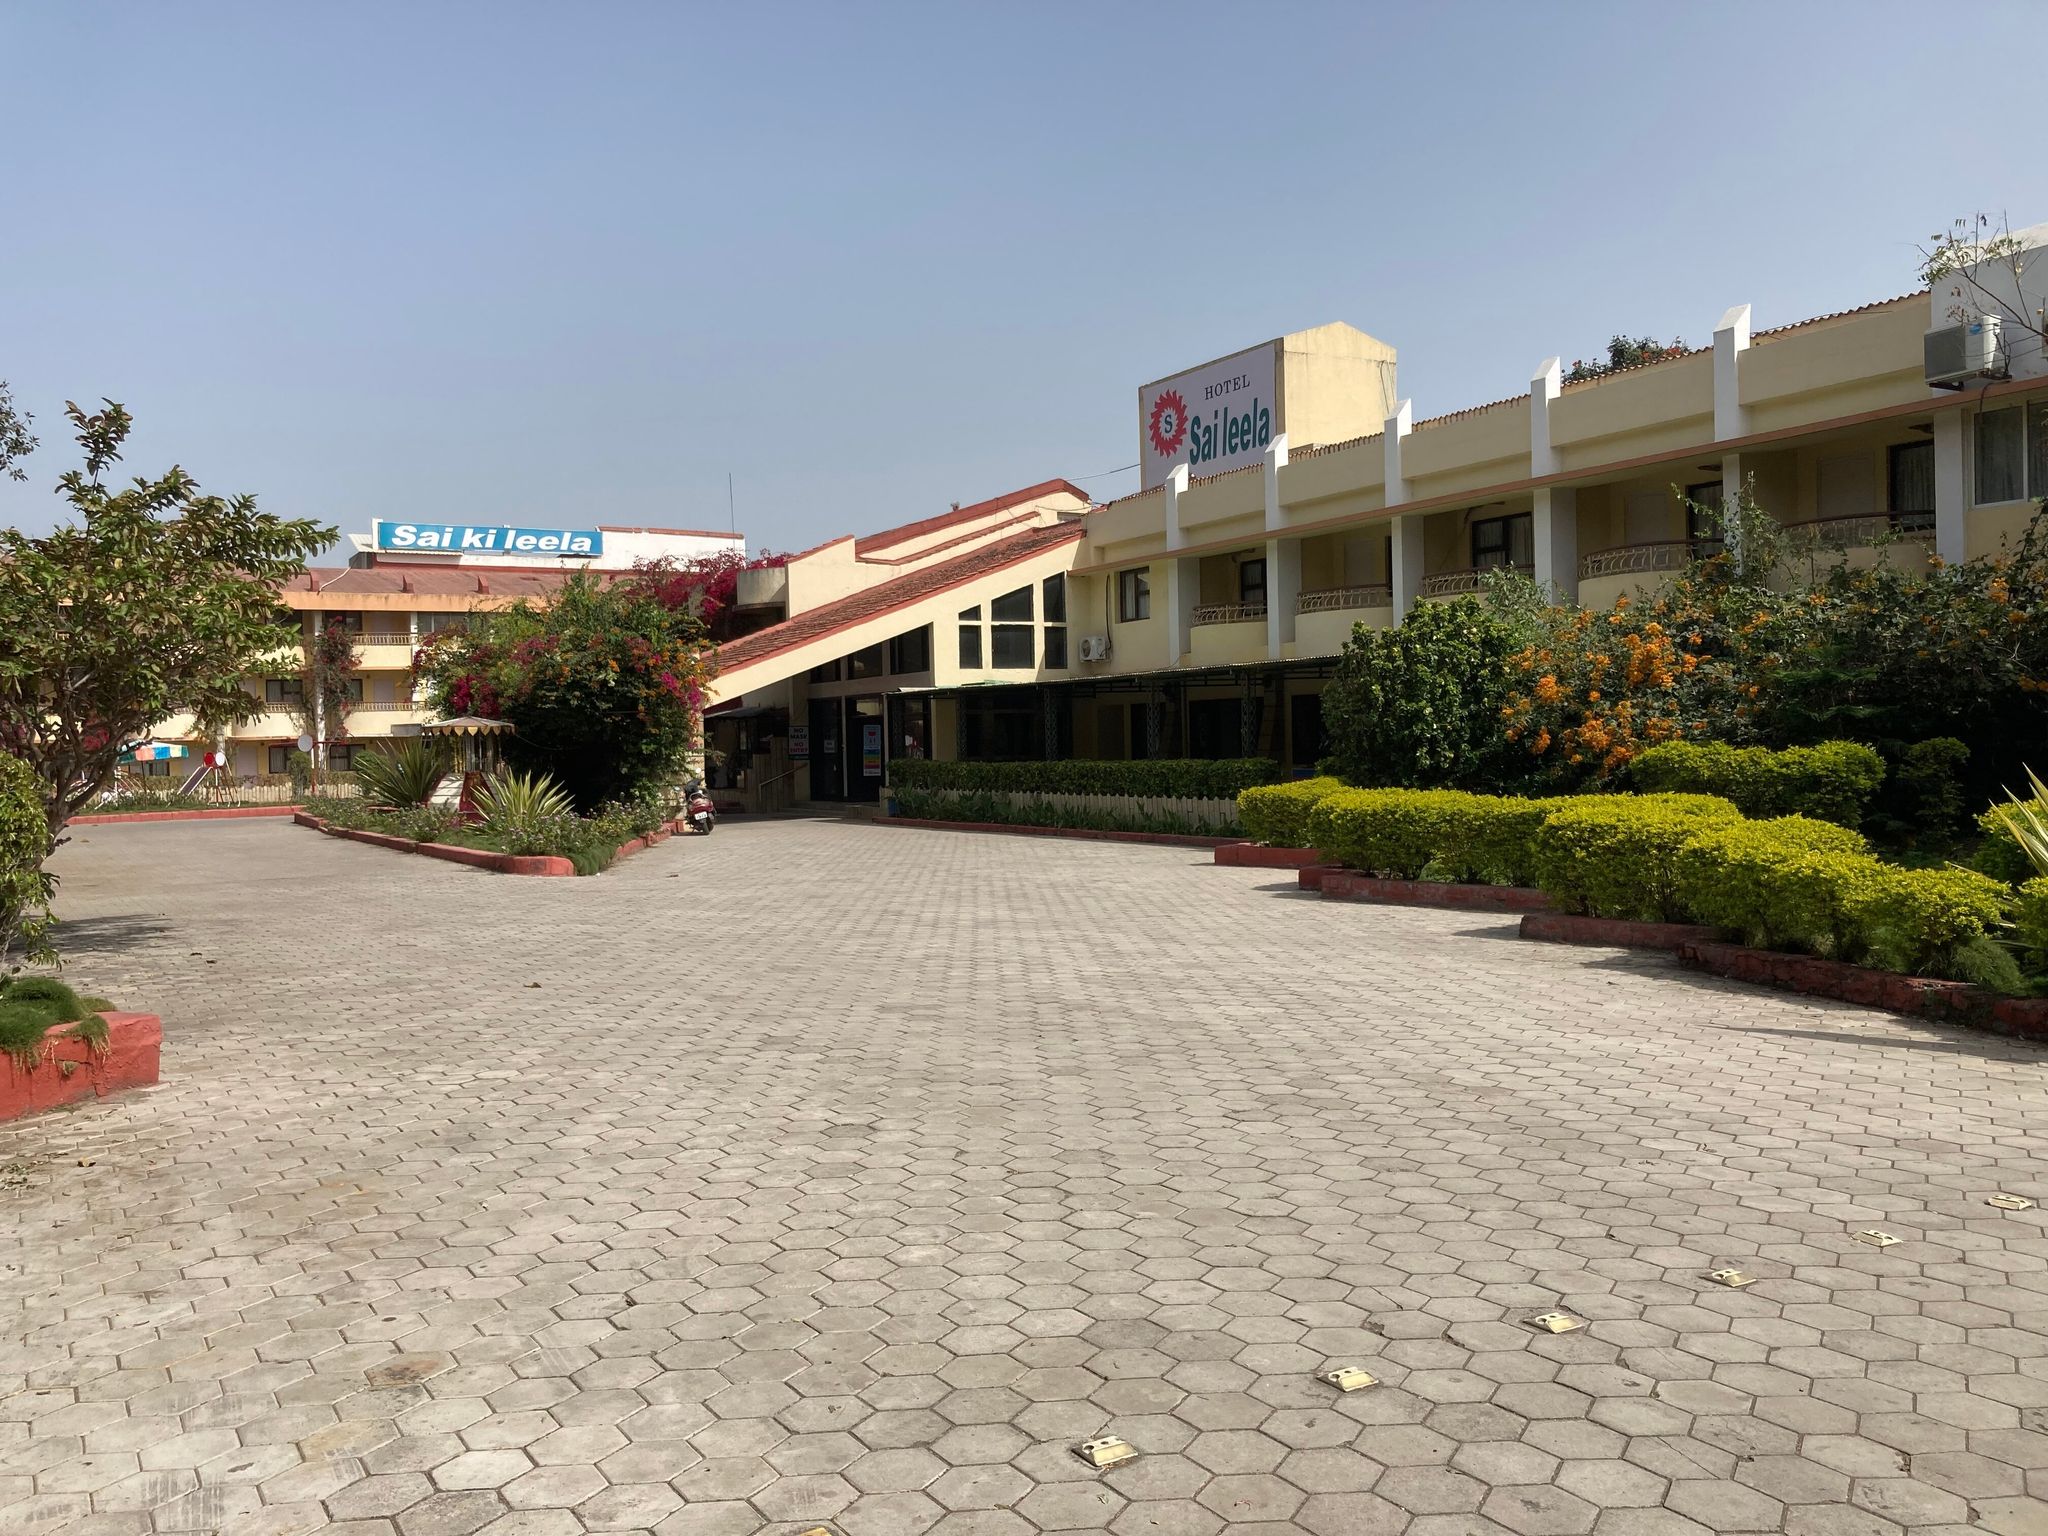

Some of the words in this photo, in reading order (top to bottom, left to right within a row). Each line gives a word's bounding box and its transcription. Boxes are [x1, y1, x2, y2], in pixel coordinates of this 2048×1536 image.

[1204, 374, 1251, 400] HOTEL
[1189, 410, 1218, 465] Sai
[1222, 397, 1270, 457] leela
[391, 525, 453, 548] Sai
[461, 528, 497, 549] ki
[504, 529, 592, 553] leela
